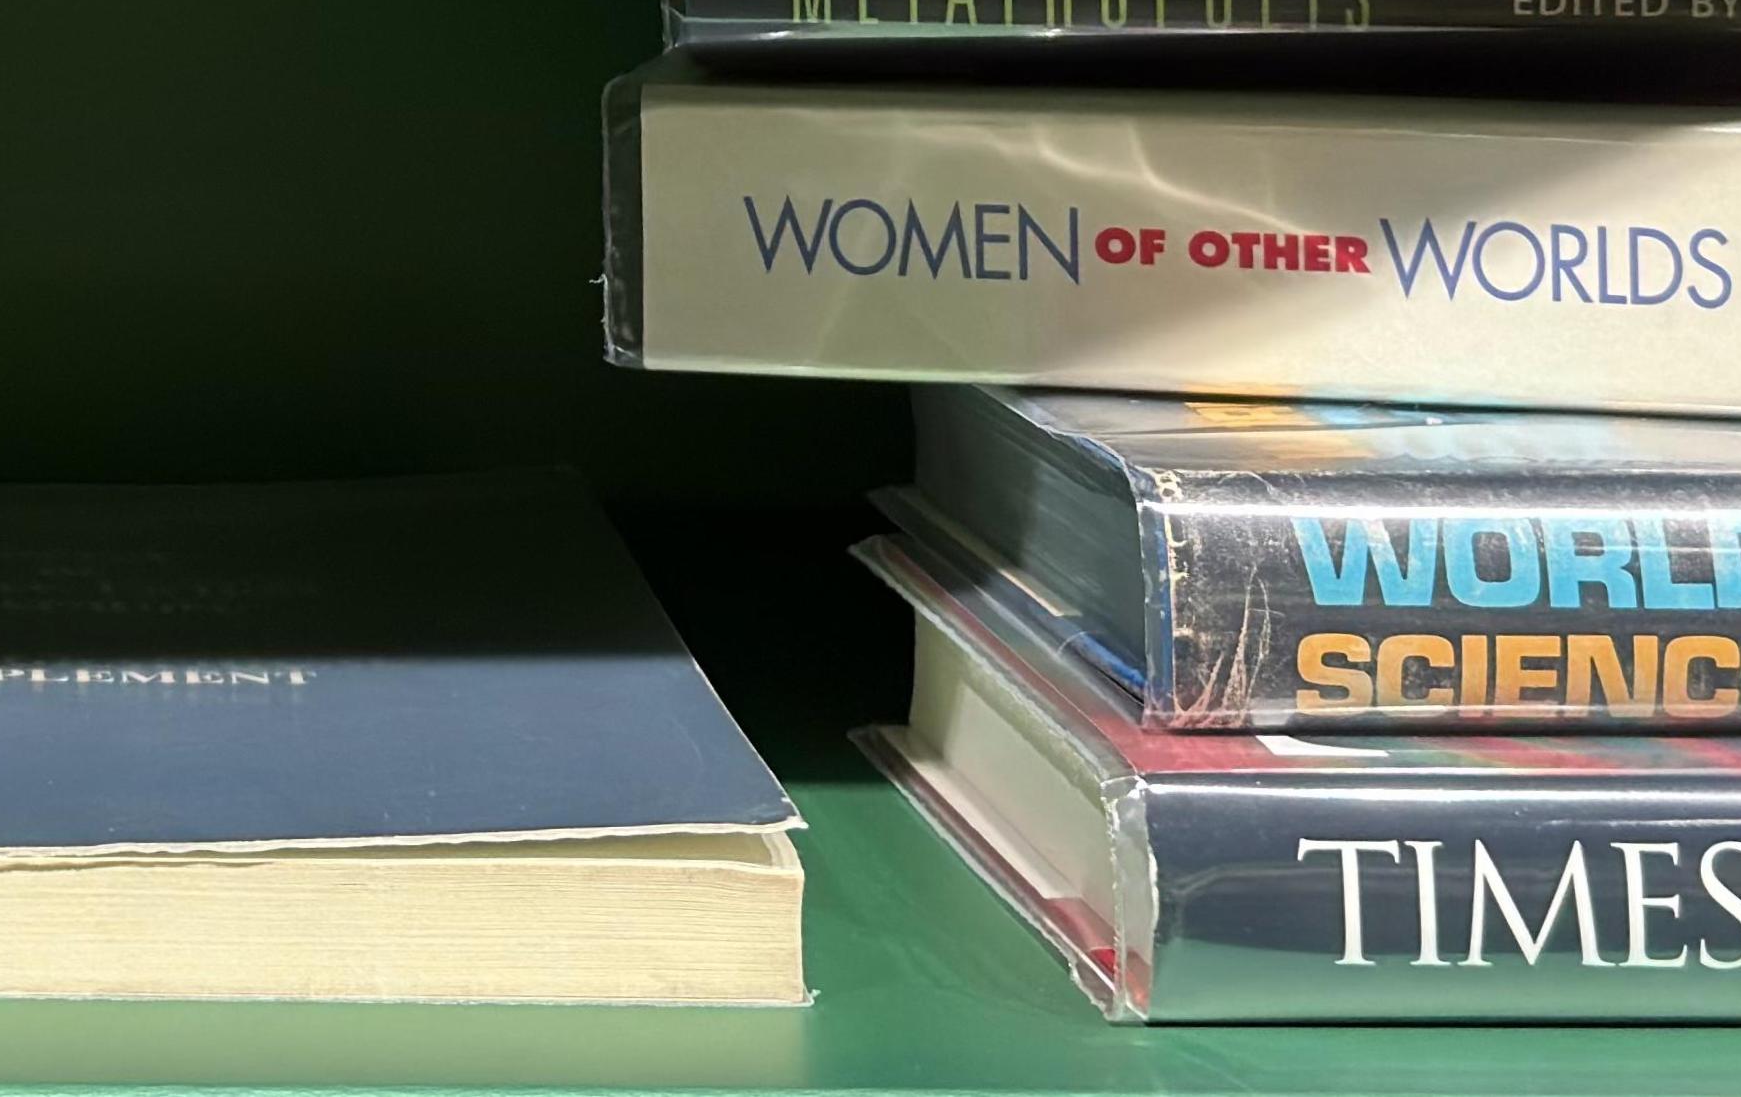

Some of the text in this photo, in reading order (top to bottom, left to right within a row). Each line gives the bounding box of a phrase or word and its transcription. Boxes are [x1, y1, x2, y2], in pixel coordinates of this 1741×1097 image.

[743, 195, 1732, 309] WOMEN OF OTHER WORLDS
